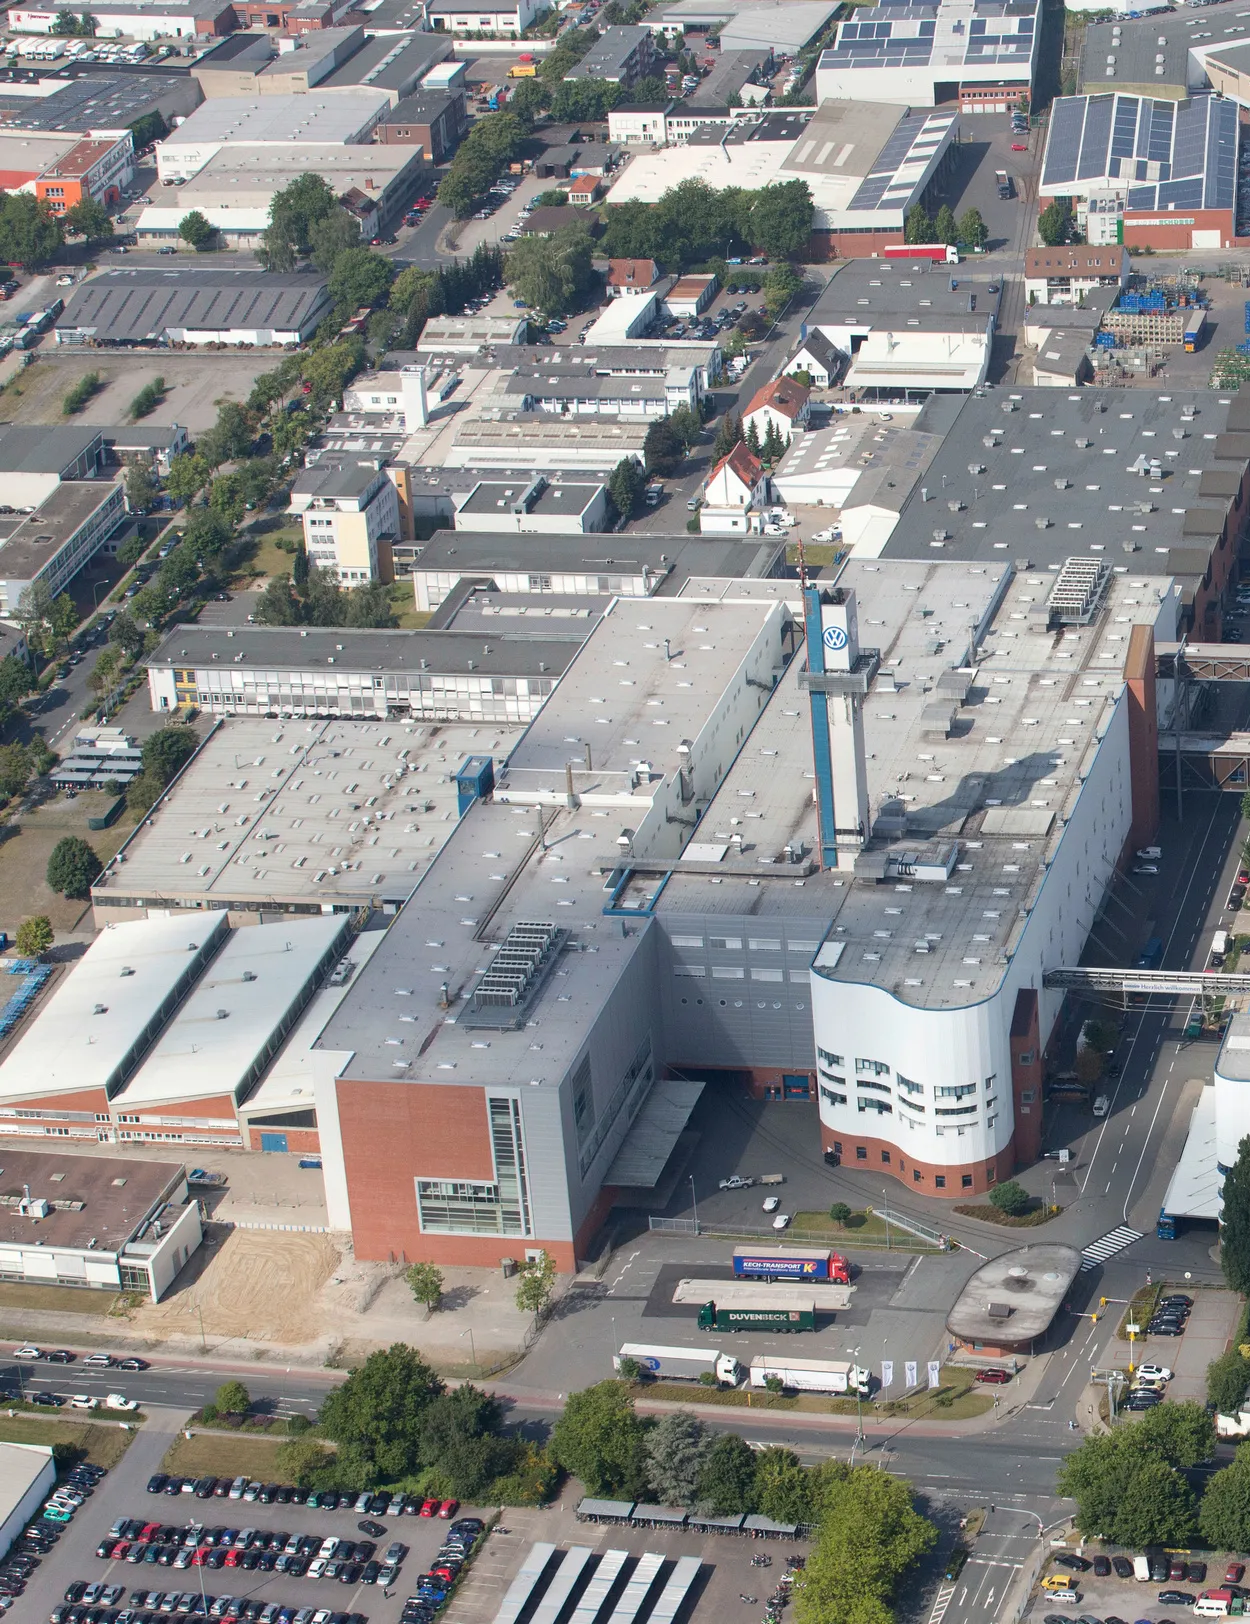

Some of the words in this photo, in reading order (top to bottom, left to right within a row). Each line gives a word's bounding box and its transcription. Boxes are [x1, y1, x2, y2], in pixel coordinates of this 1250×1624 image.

[1140, 983, 1164, 991] Herzlich
[743, 1261, 801, 1269] KECH-TRANSPORT
[803, 1263, 813, 1273] K
[729, 1313, 787, 1321] DUVENBECK
